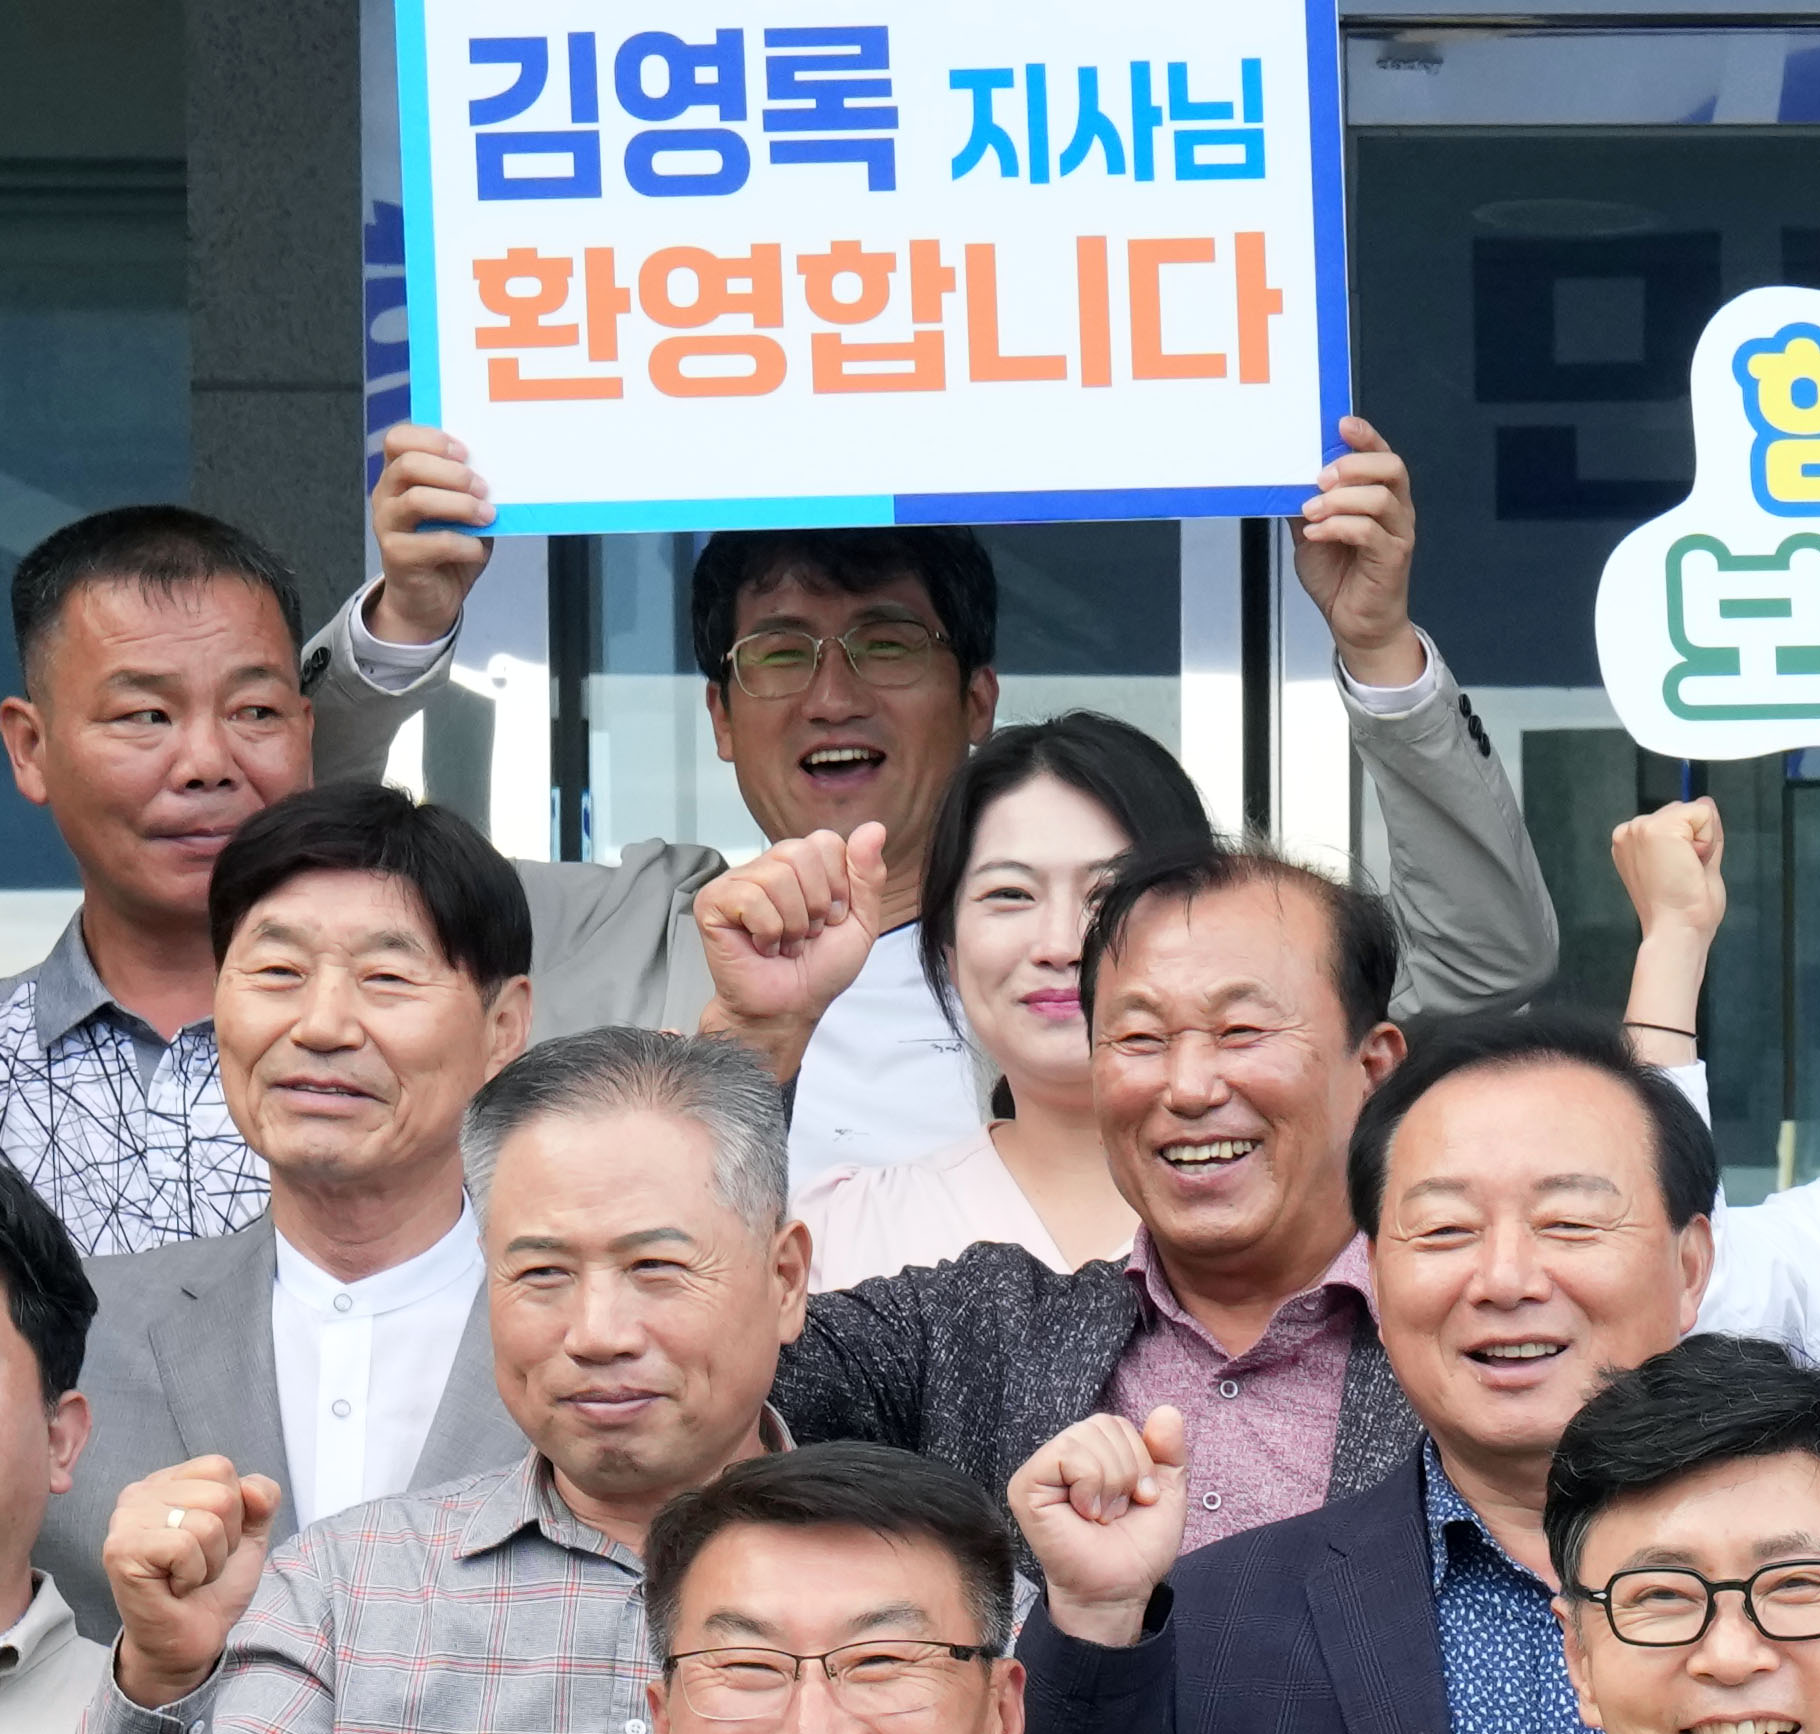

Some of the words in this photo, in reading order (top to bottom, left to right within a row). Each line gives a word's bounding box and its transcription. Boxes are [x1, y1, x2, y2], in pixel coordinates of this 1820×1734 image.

[469, 26, 899, 202] 김영록
[949, 58, 1267, 186] 지사님
[474, 232, 1282, 402] 환영합니다
